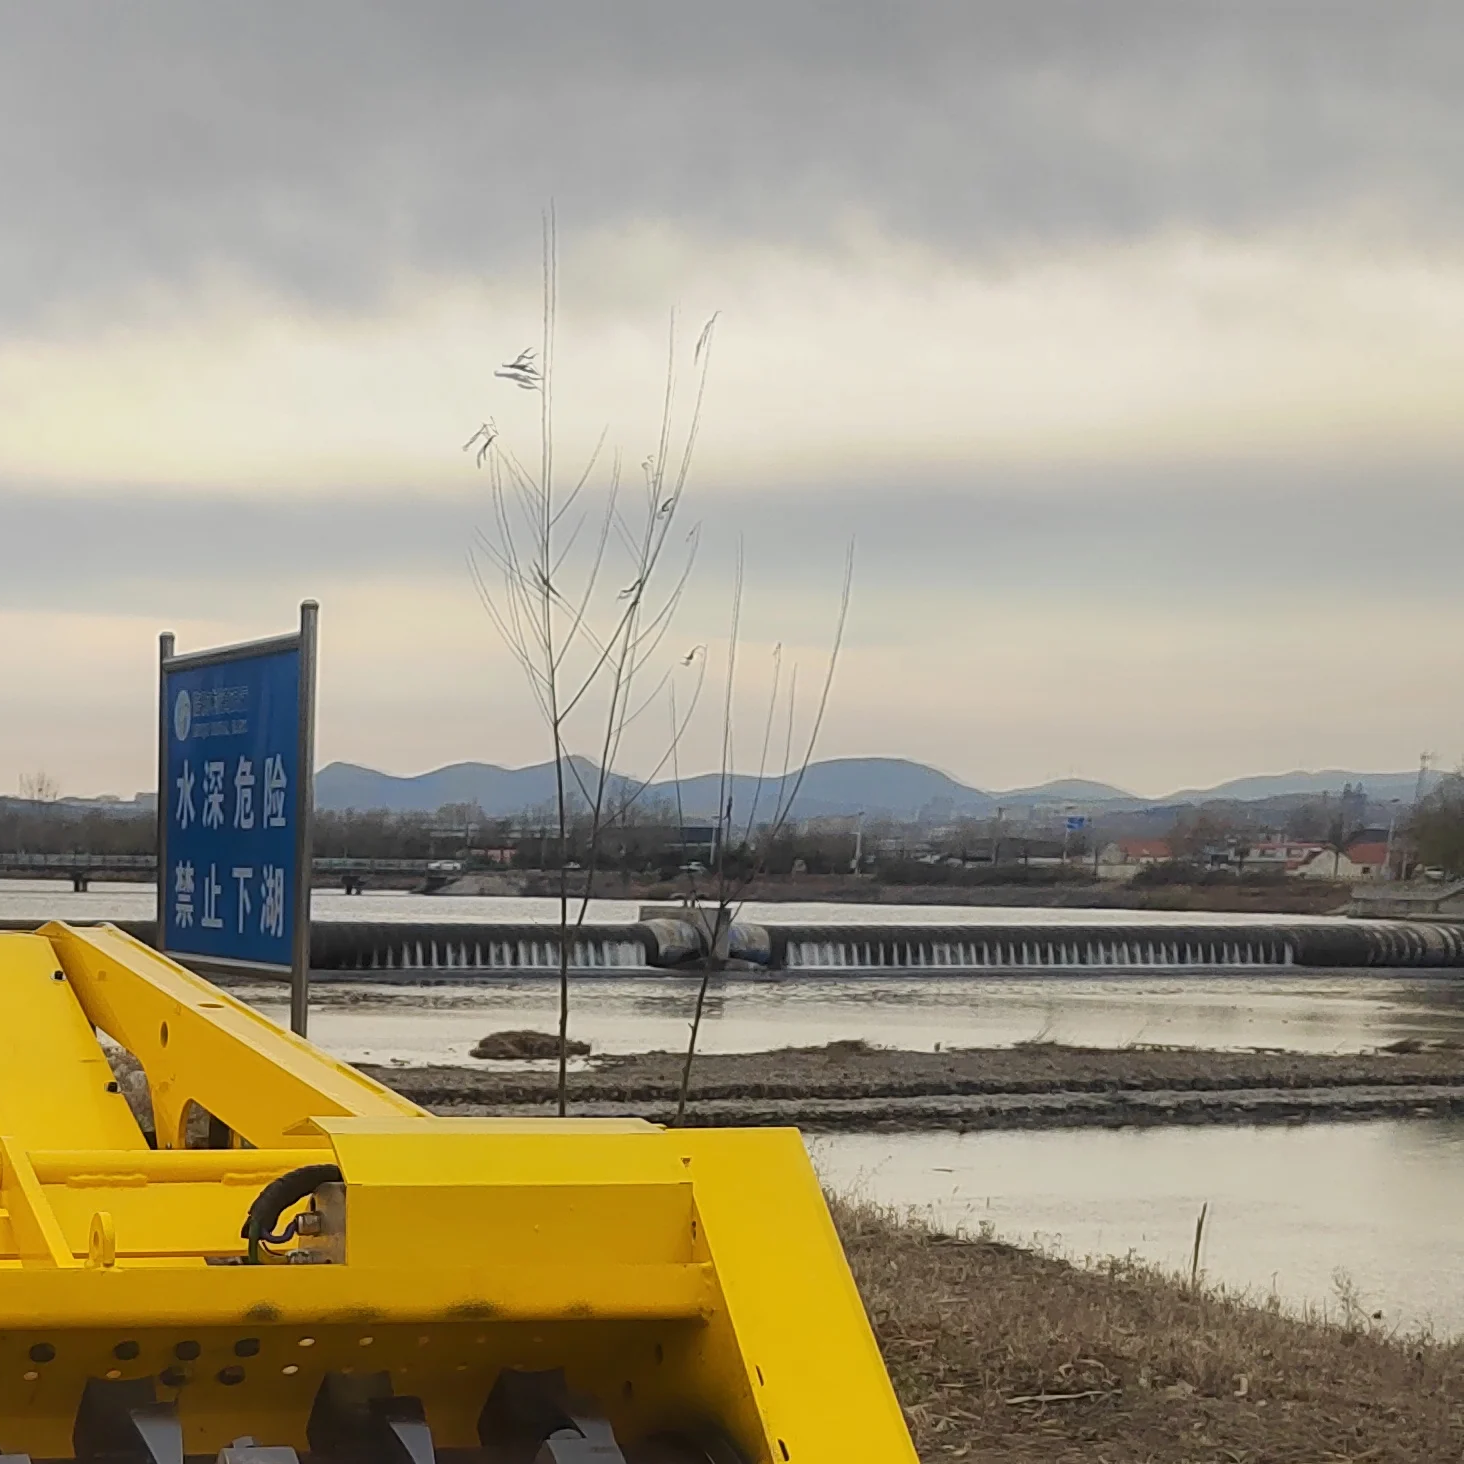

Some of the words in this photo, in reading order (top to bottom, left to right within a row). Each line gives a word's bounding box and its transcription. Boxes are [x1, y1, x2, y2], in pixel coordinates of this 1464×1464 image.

[175, 754, 287, 830] 水深危险
[175, 859, 284, 937] 禁止下湖
